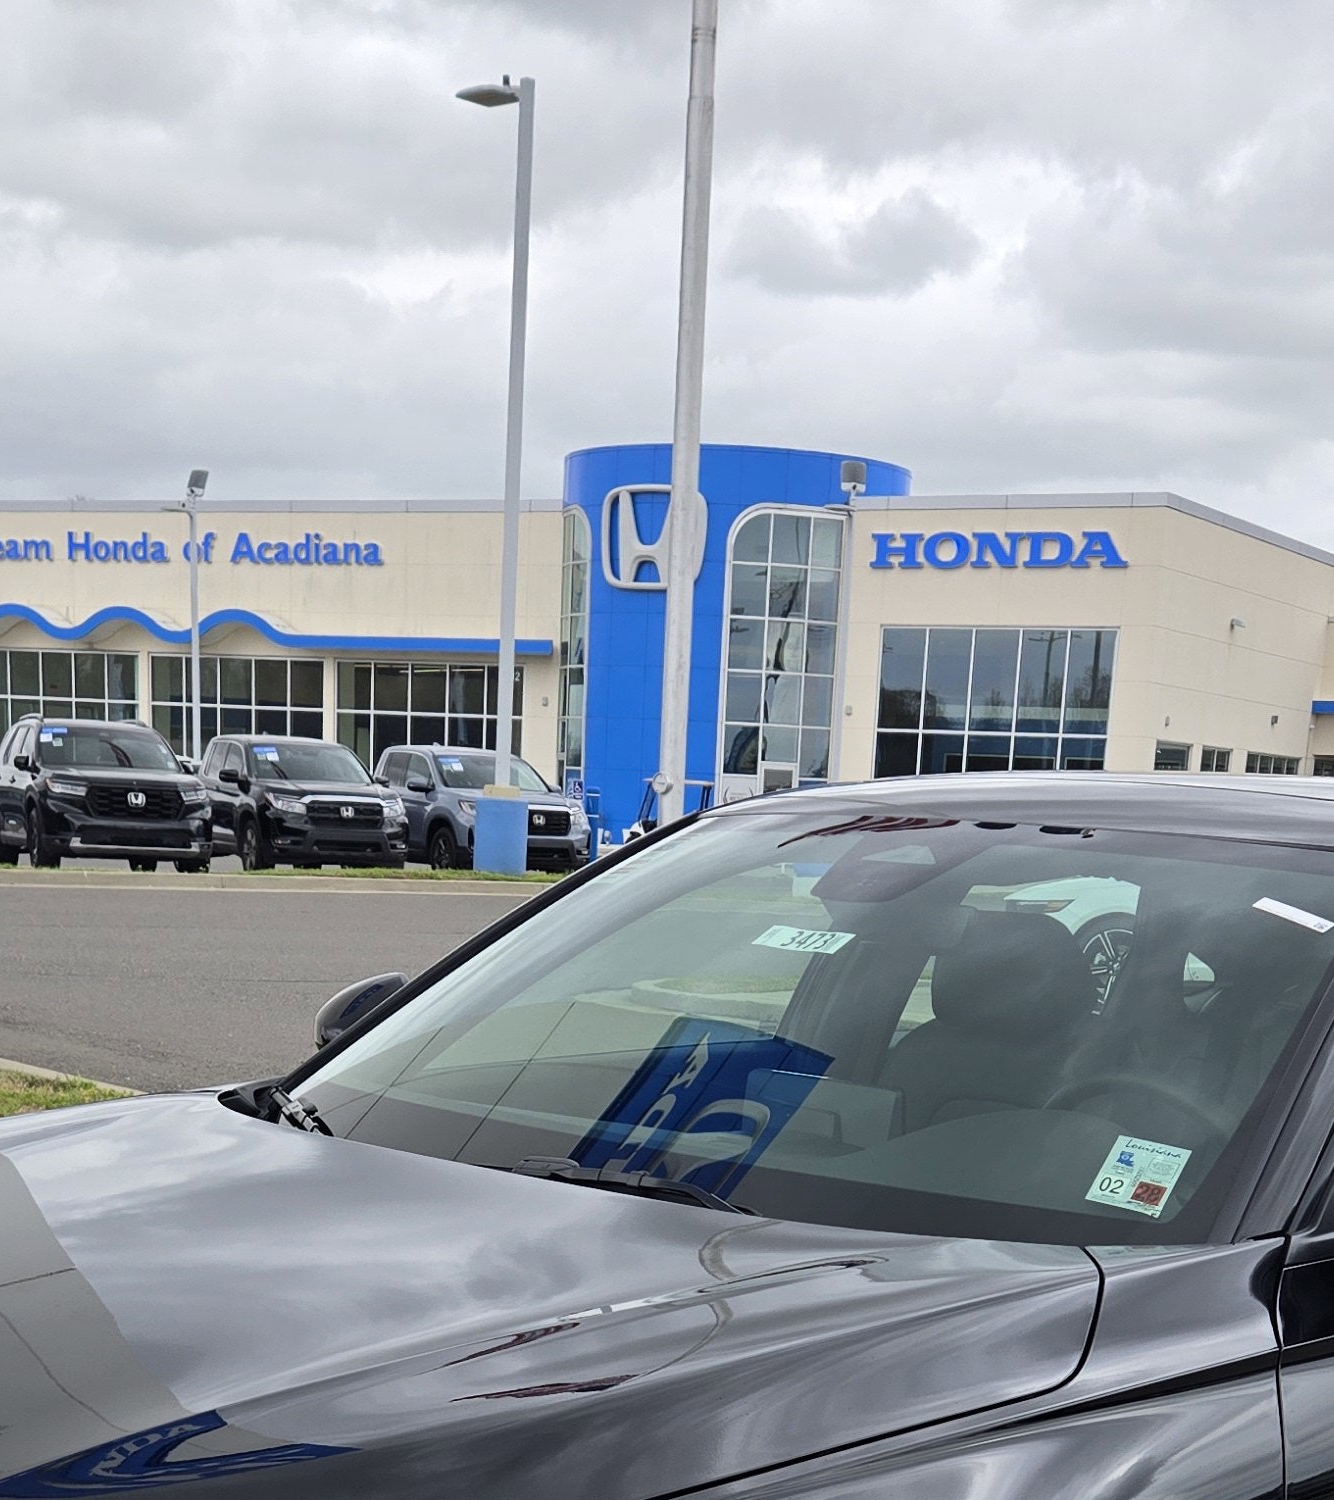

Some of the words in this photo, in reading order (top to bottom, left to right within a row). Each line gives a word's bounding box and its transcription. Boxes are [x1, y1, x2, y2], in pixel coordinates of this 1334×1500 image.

[66, 531, 169, 562] Honda
[182, 532, 216, 562] of
[230, 533, 382, 565] Acadiana
[869, 531, 1128, 569] HONDA
[780, 931, 836, 949] 3473
[1125, 1139, 1182, 1159] Louisiana
[1099, 1177, 1124, 1194] 02
